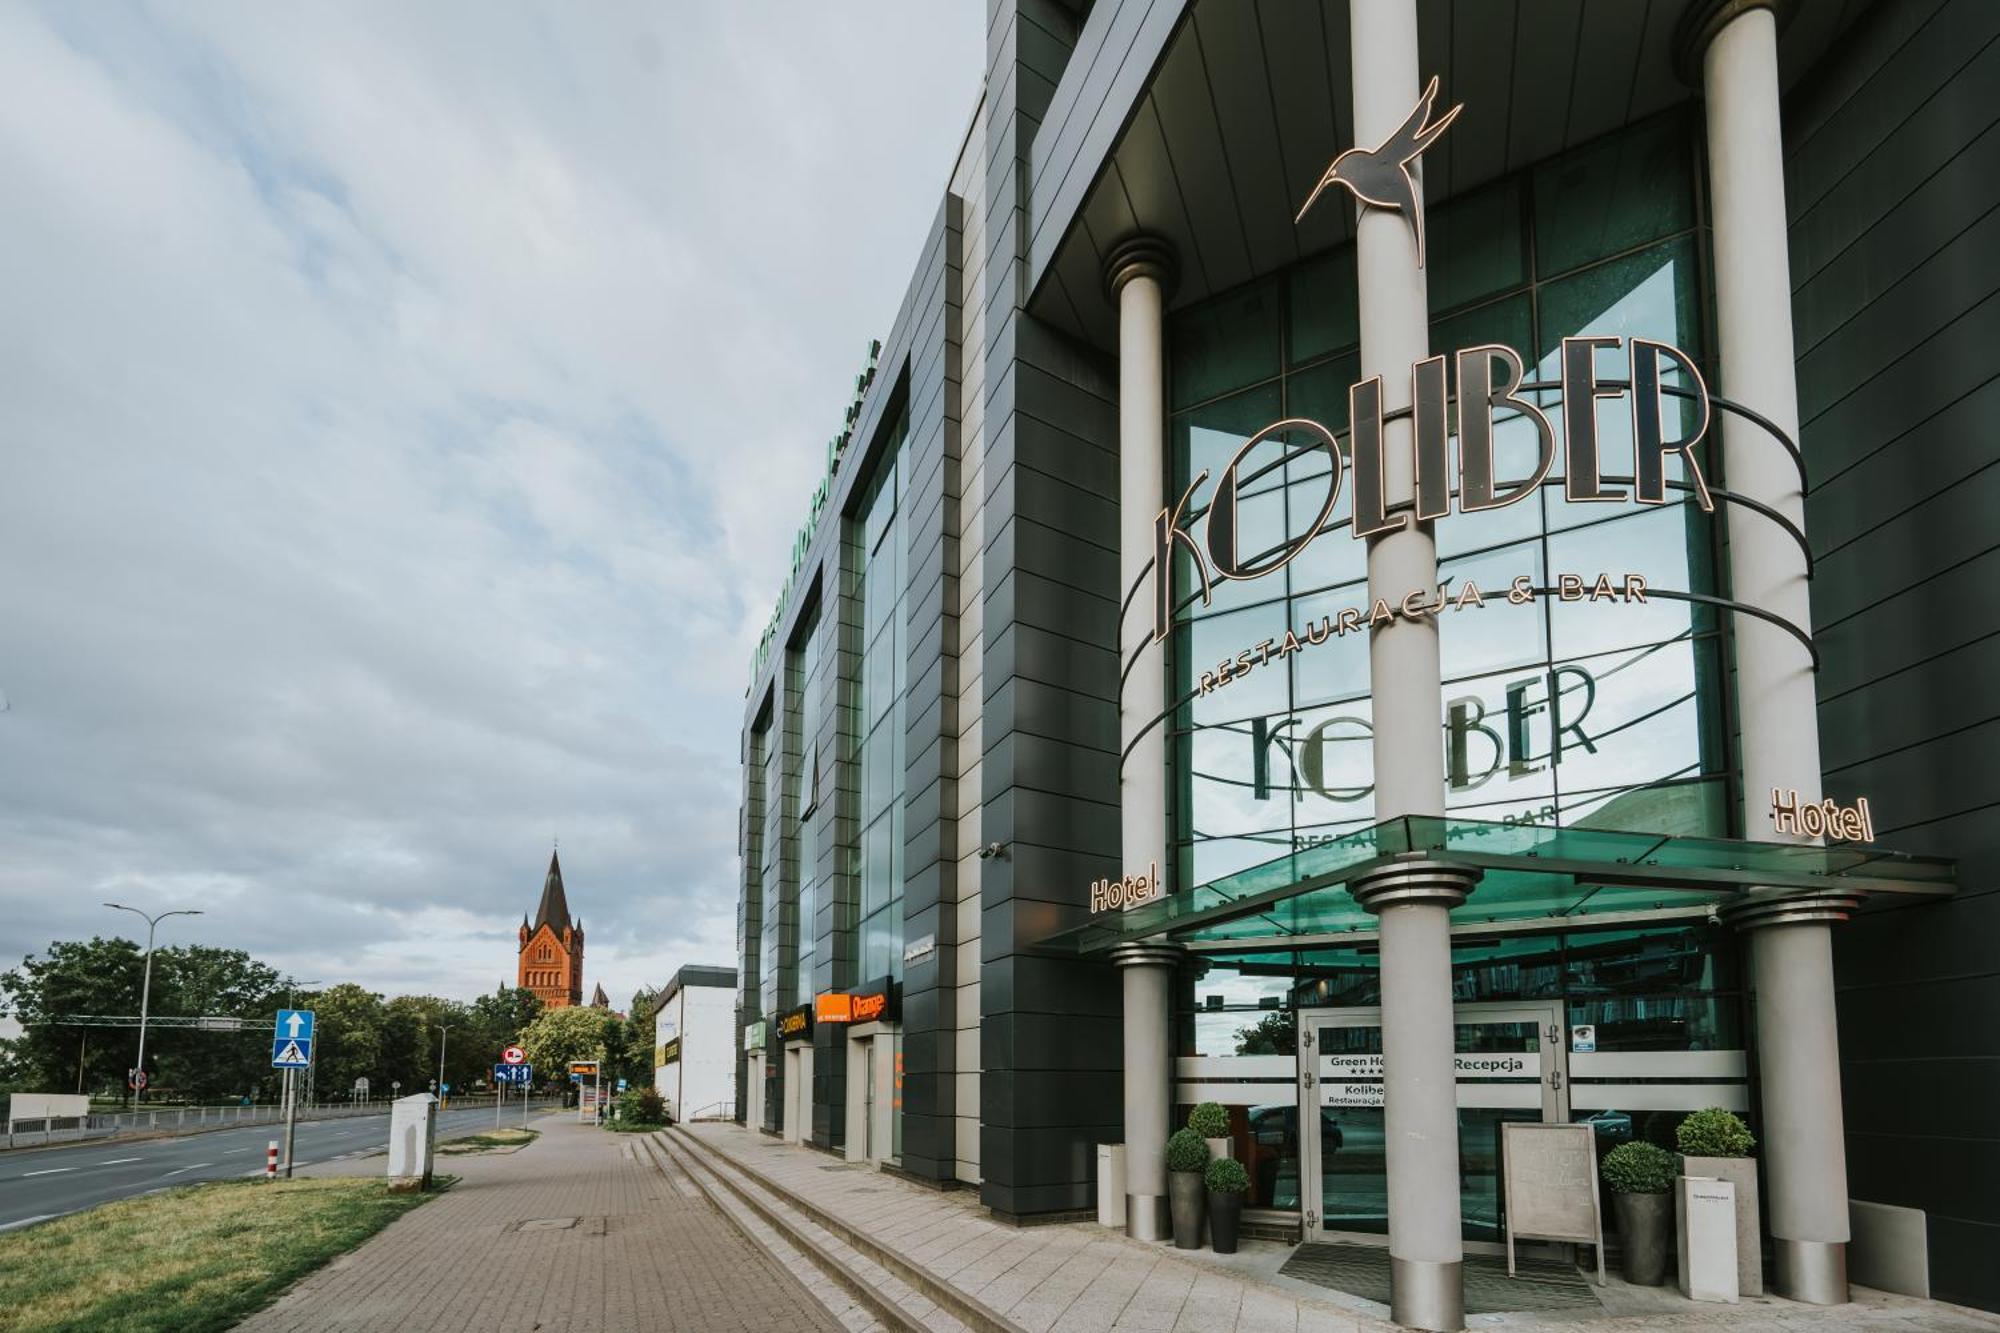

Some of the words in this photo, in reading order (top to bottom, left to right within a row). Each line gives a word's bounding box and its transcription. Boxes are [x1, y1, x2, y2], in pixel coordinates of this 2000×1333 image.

[1153, 336, 1715, 645] KOLIBER
[1199, 580, 1485, 698] RESTAURACJA
[1508, 575, 1536, 605] &
[1558, 573, 1648, 604] BAR
[1251, 664, 1598, 803] KOBER
[1771, 786, 1875, 842] Hotel
[1091, 859, 1157, 914] Hotel
[852, 994, 886, 1018] Orange
[1331, 1056, 1367, 1066] Green
[1454, 1057, 1523, 1072] Recepcja
[1329, 1096, 1381, 1106] Restauracja
